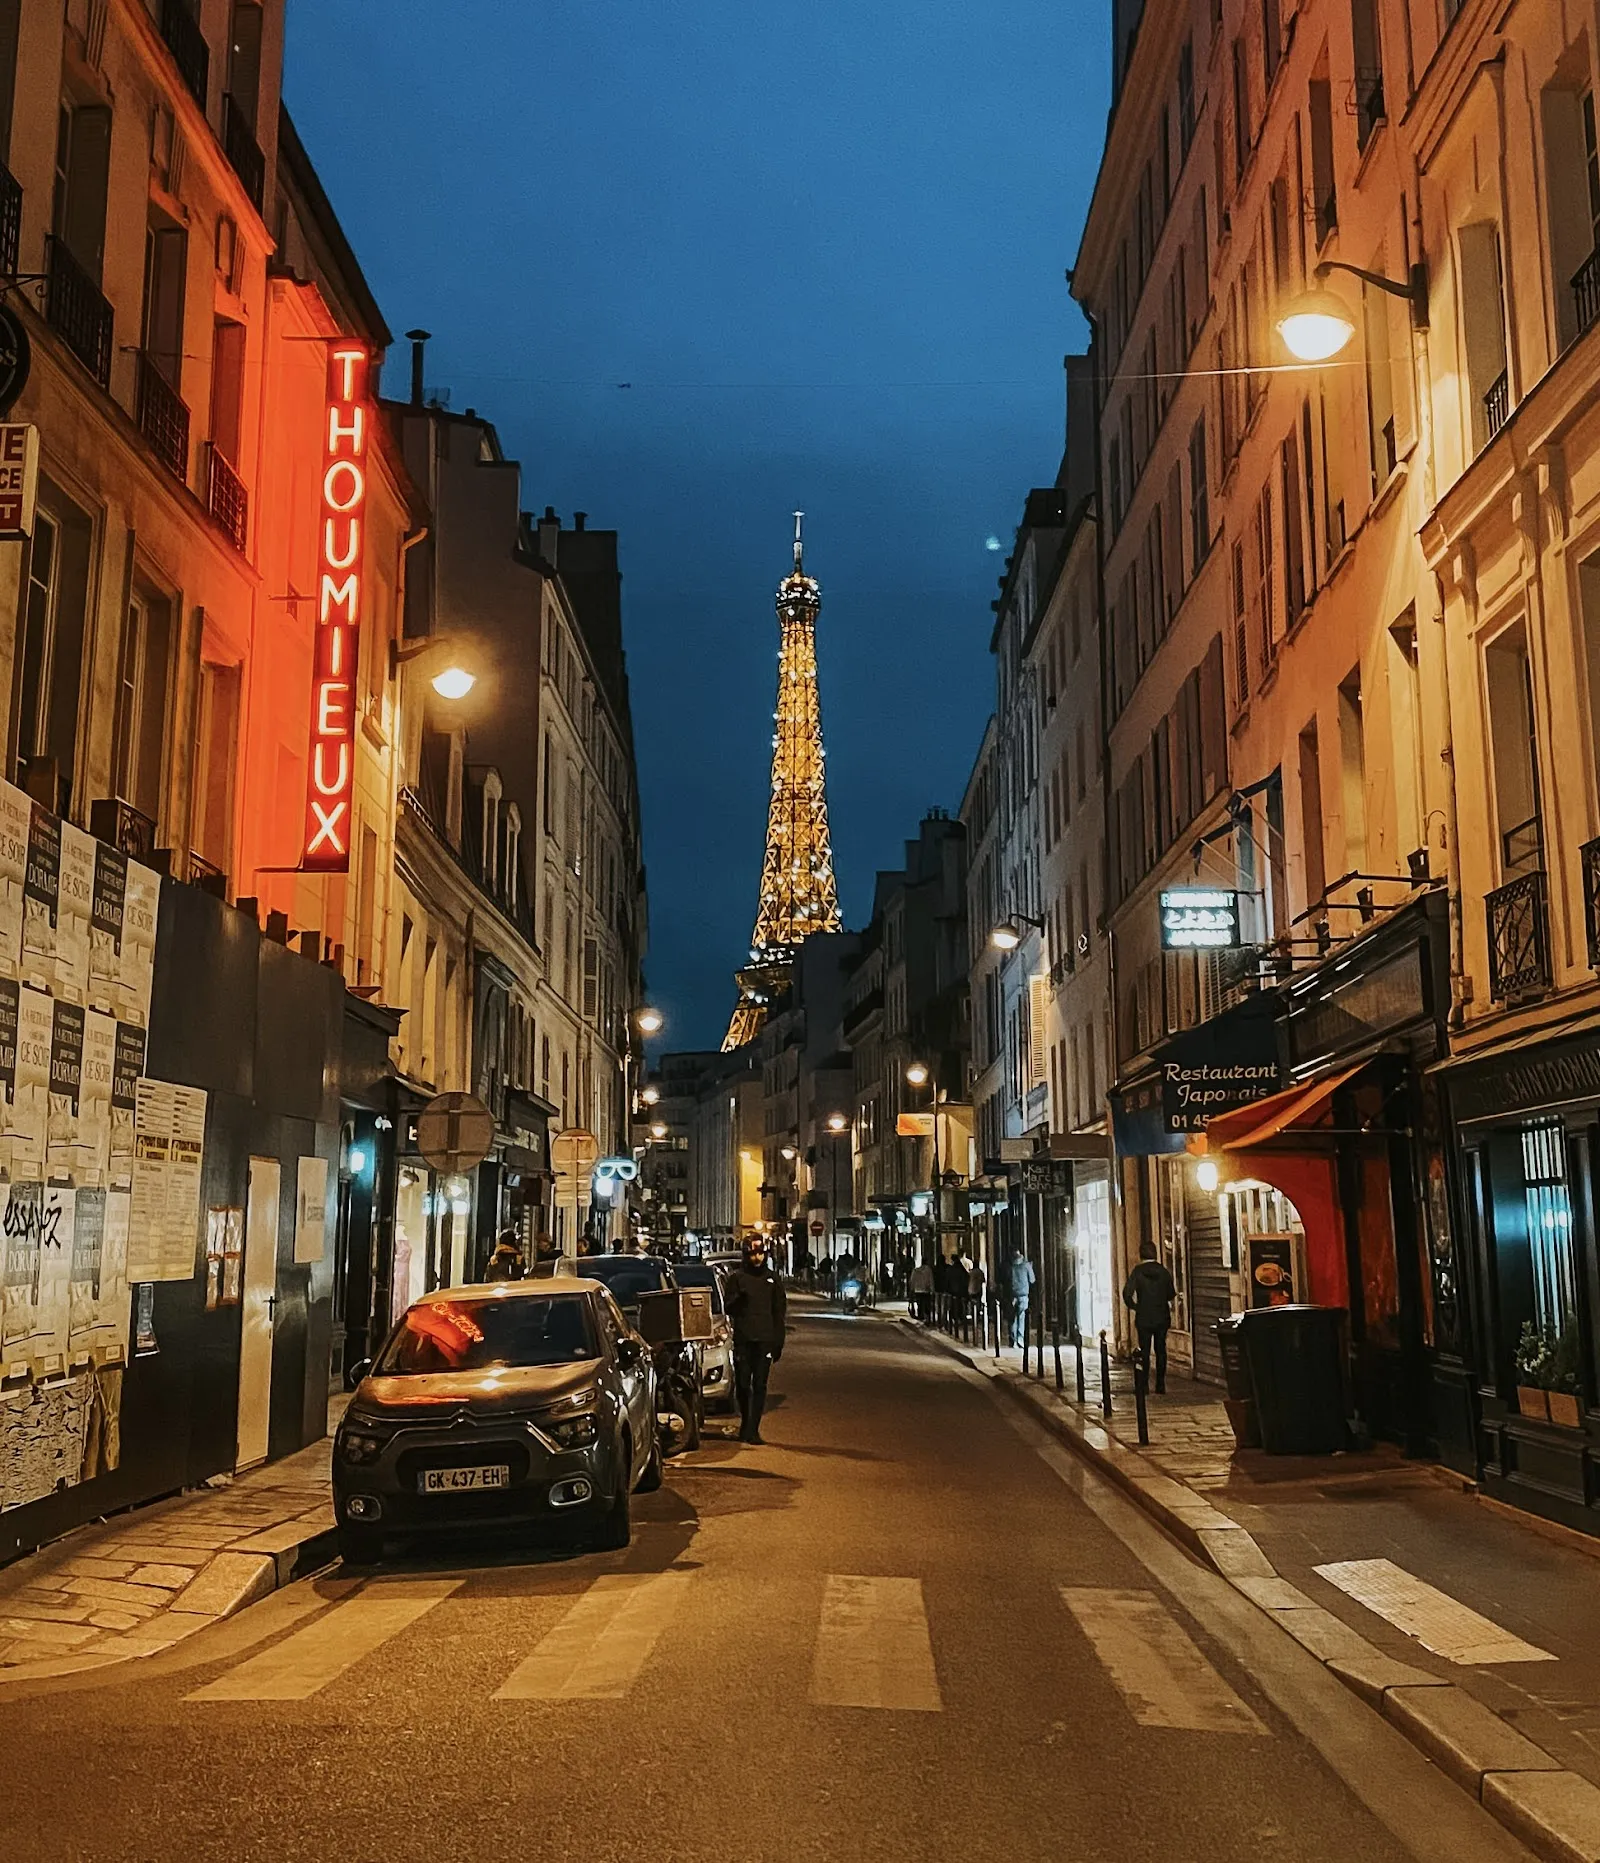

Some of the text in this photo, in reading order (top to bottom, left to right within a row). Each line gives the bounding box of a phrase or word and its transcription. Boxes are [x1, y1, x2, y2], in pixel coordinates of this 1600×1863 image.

[307, 350, 366, 855] THOUMIEUX
[1164, 1062, 1279, 1082] Restaurant
[1546, 1049, 1600, 1093] DOMIN
[1177, 1083, 1269, 1108] Japonais
[1171, 1114, 1188, 1129] 01
[1023, 1171, 1052, 1182] Marc
[427, 1469, 499, 1488] GK-437-EH
